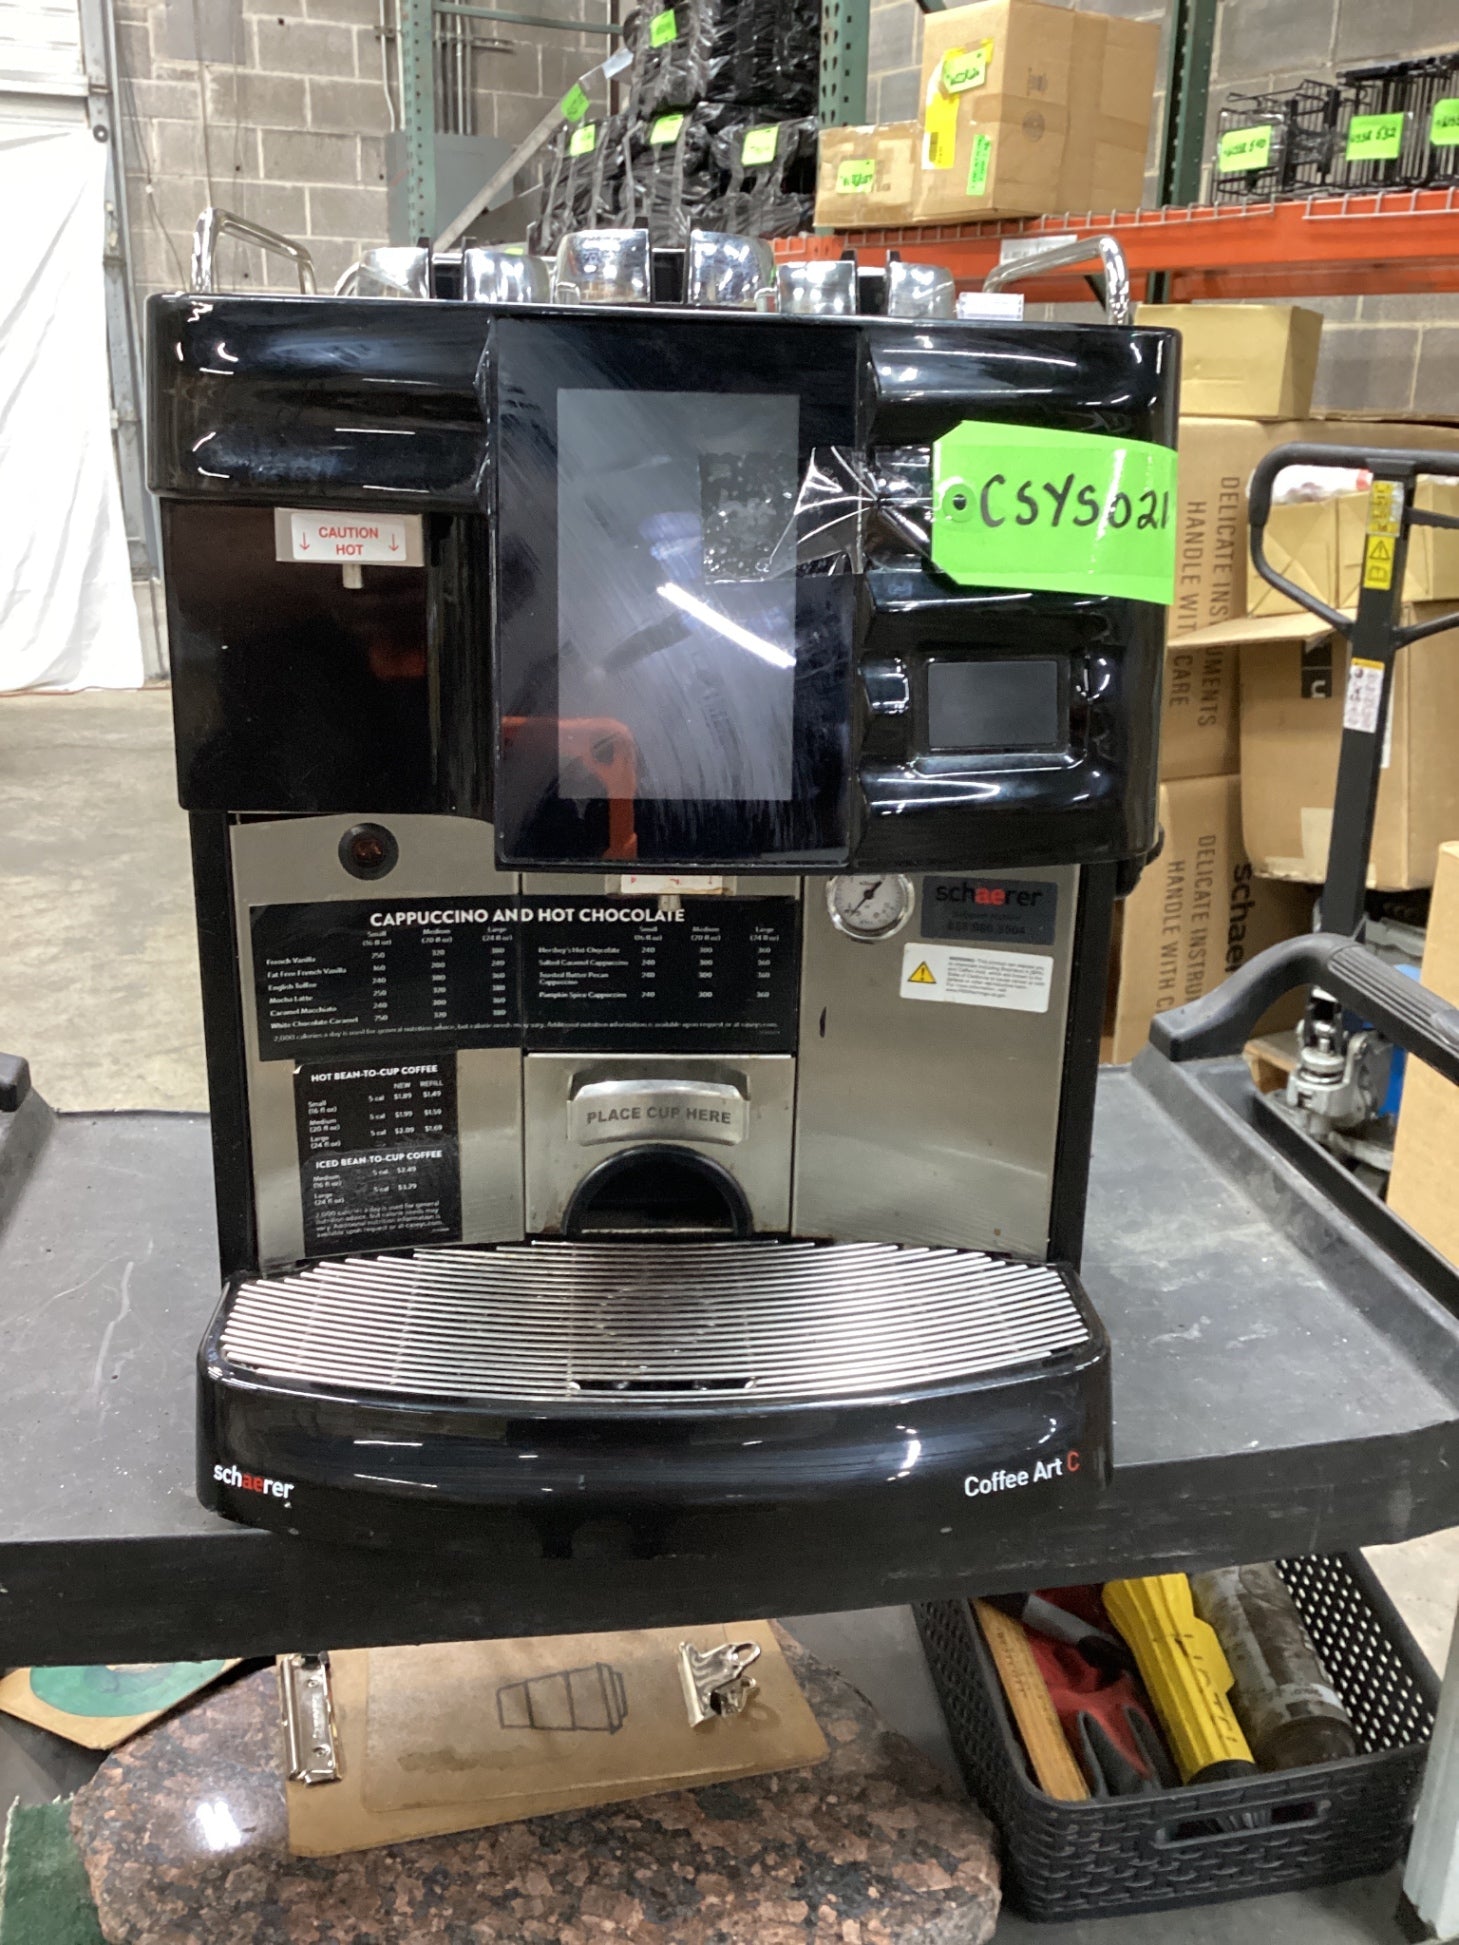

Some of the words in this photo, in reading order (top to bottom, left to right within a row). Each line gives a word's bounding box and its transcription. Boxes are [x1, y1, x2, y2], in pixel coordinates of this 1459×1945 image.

[318, 526, 379, 539] CAUTION
[1181, 501, 1207, 585] HANDLE
[1213, 477, 1240, 574] DELICATE
[336, 544, 364, 555] HOT
[1178, 593, 1199, 632] WIT
[1197, 582, 1231, 726] INSTUMENTS
[1169, 655, 1193, 707] CARE
[936, 882, 1045, 907] schaerer
[1162, 860, 1185, 934] HANDLE
[1190, 834, 1216, 923] DELICATE
[370, 909, 488, 926] CAPPUCCINO
[492, 909, 534, 922] AND
[538, 908, 575, 922] HOT
[579, 908, 685, 922] CHOCOLATE
[1158, 941, 1178, 991] WITH
[311, 1073, 332, 1082] HOT
[334, 1069, 400, 1081] BEAN-TO-CUP
[401, 1065, 438, 1074] COFFEE
[309, 1118, 336, 1126] Medium
[586, 1107, 641, 1124] PLACE
[646, 1107, 681, 1119] CUP
[686, 1107, 731, 1124] HERE
[316, 1159, 339, 1168] ICED
[407, 1150, 442, 1160] COFFEE
[213, 1464, 294, 1499] schaerer
[964, 1469, 1029, 1497] Coffee
[1033, 1457, 1063, 1482] Art
[1066, 1450, 1080, 1472] C
